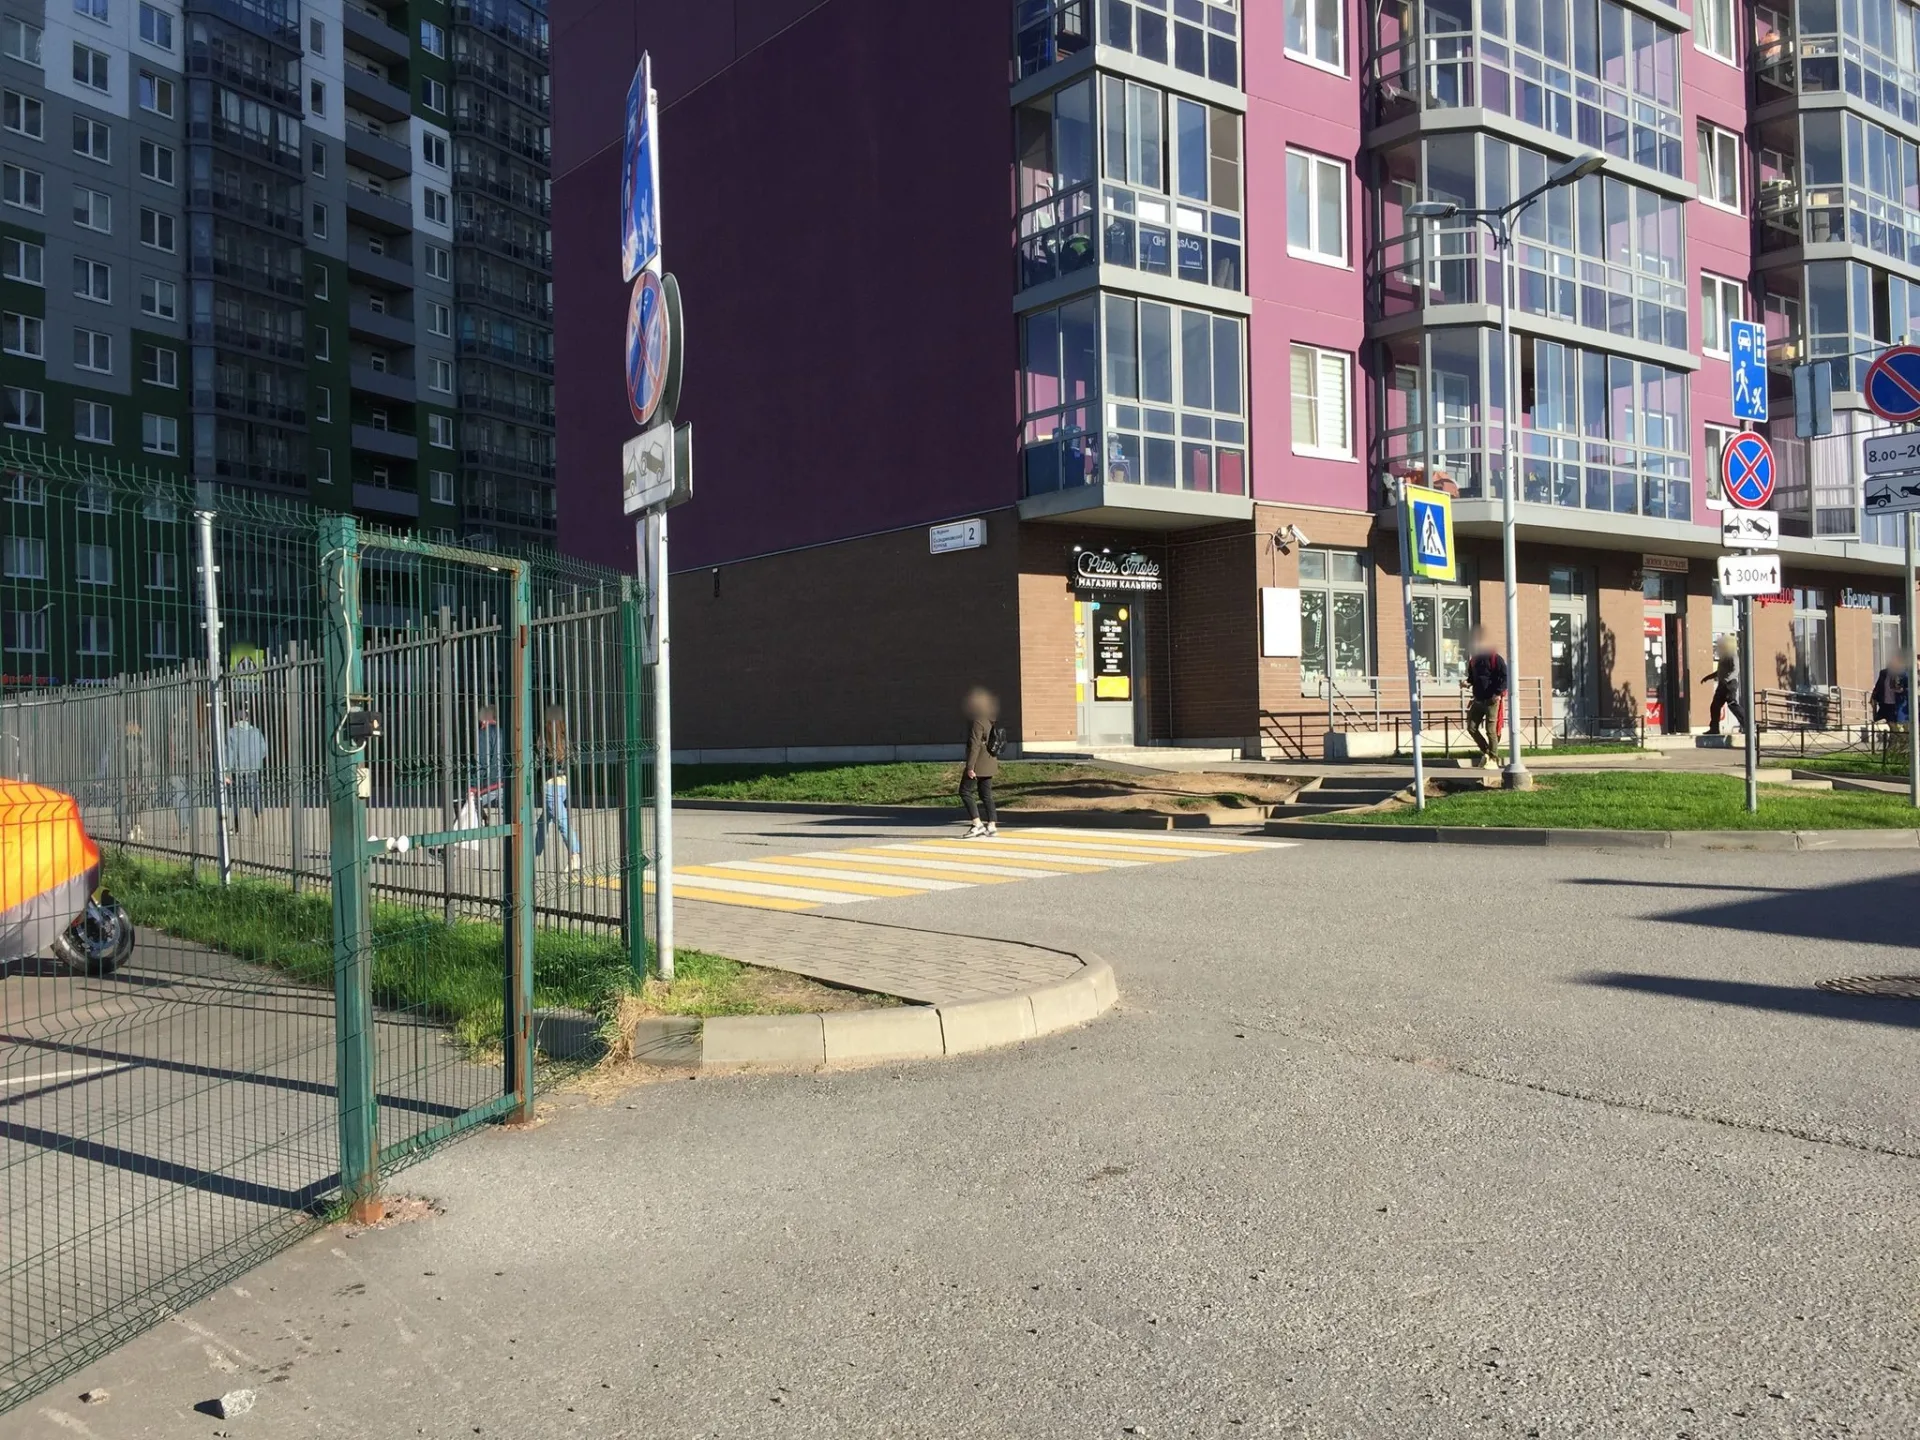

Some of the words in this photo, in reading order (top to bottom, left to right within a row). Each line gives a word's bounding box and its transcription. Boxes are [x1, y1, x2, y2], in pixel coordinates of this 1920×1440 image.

[968, 527, 975, 540] 2
[1078, 551, 1119, 574] Piter
[1120, 557, 1160, 576] Smoke
[1079, 577, 1118, 588] МАГАЗИН
[1119, 580, 1163, 591] КАЛЬЯНОВ
